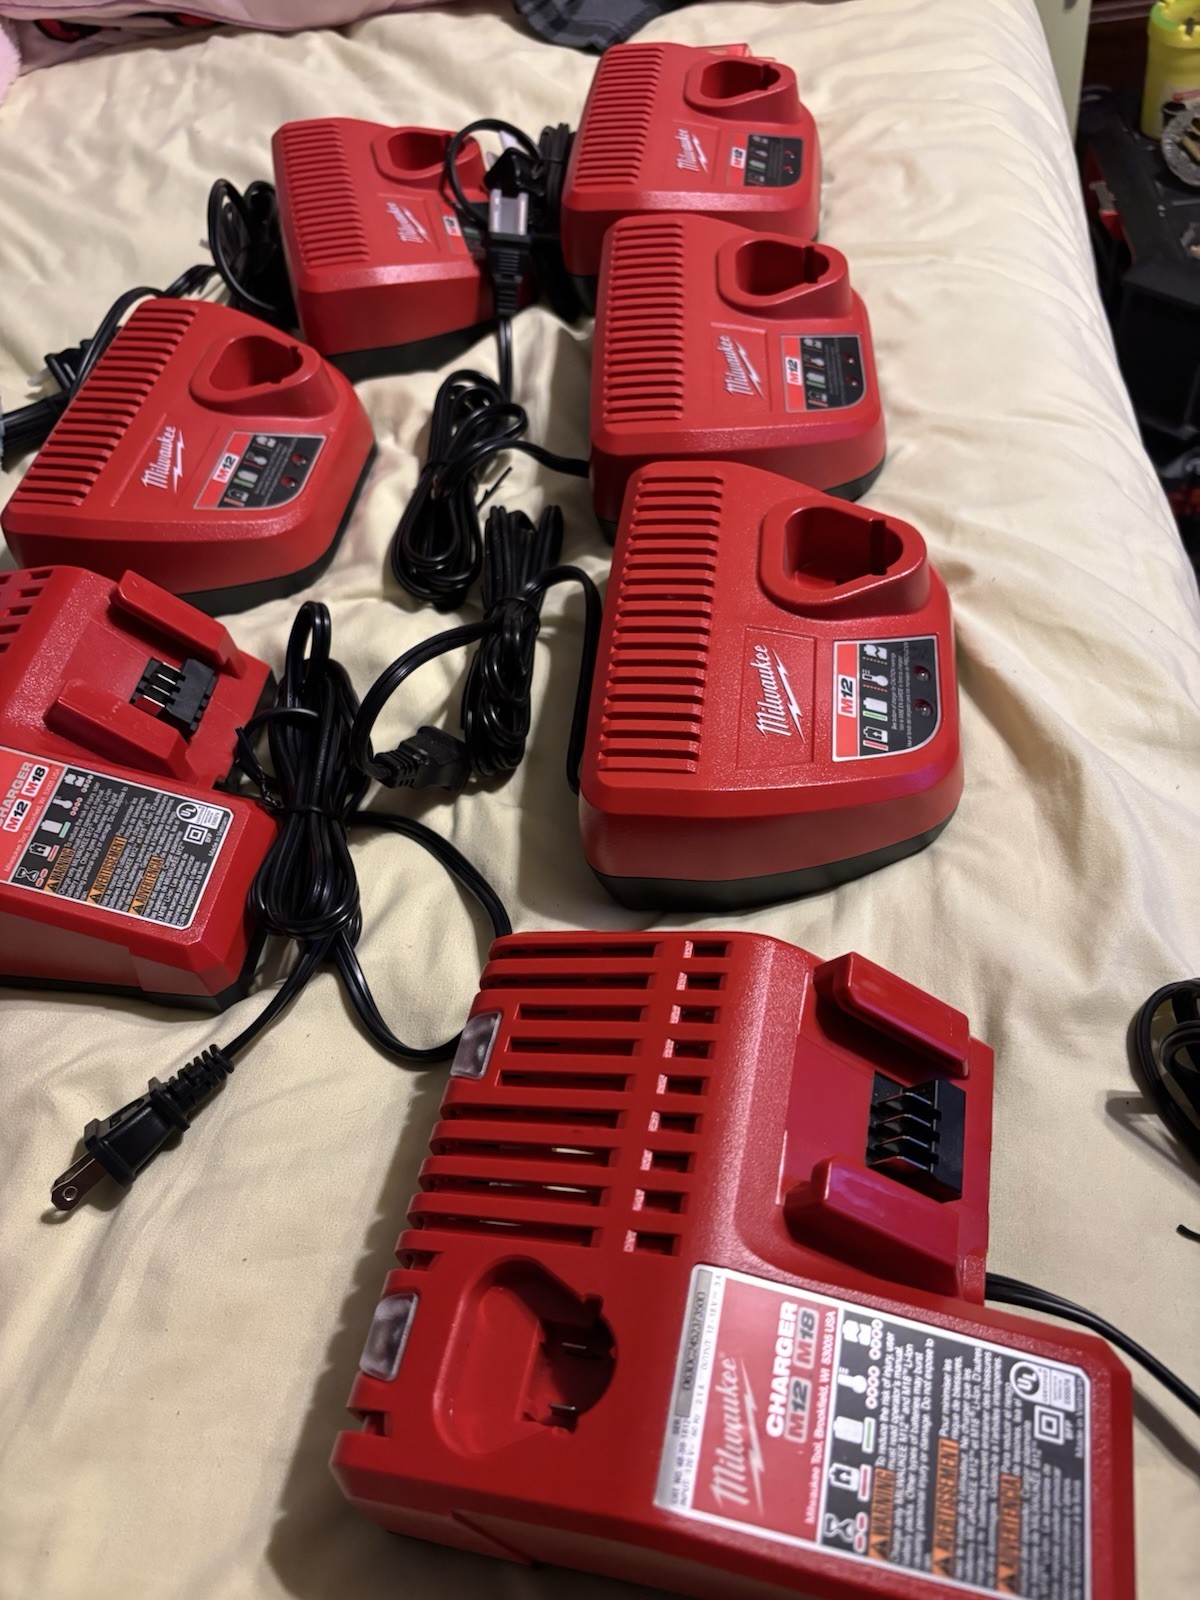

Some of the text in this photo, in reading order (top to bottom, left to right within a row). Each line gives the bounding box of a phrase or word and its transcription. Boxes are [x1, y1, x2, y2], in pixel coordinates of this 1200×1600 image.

[717, 335, 755, 395] Milwaukee
[787, 359, 799, 383] M12
[141, 426, 176, 490] Milwaukee
[216, 457, 236, 478] M12
[750, 645, 792, 739] Milwaukee
[840, 677, 852, 714] M12
[5, 766, 46, 830] M12 M18
[50, 848, 74, 881] WARNING
[92, 836, 126, 892] AVERTISSEMENT
[134, 856, 163, 903] ADVERTENCIA
[824, 1309, 838, 1333] USA
[821, 1333, 835, 1366] 53005
[885, 1330, 896, 1353] user
[924, 1336, 934, 1349] to
[764, 1299, 798, 1439] CHARGER
[787, 1309, 817, 1439] M12 M18
[913, 1350, 923, 1375] burst
[922, 1346, 935, 1381] expose
[942, 1356, 953, 1373] les
[882, 1377, 892, 1389] of
[912, 1374, 923, 1395] may
[922, 1379, 931, 1396] not
[1016, 1367, 1036, 1392] UL
[880, 1388, 891, 1406] risk
[920, 1394, 931, 1412] Do
[951, 1397, 961, 1412] de
[813, 1383, 830, 1438] Brookfield,
[879, 1405, 889, 1422] the
[909, 1394, 921, 1434] batteries
[711, 1357, 749, 1505] Milwaukee
[876, 1421, 888, 1455] reduce
[887, 1423, 899, 1446] read
[938, 1414, 949, 1437] Pour
[810, 1438, 824, 1465] Tool,
[893, 1443, 907, 1506] MILWAUKEE
[900, 1395, 910, 1415] and
[909, 1433, 918, 1446] of
[875, 1454, 885, 1468] To
[885, 1445, 897, 1471] must
[803, 1464, 821, 1526] Milwaukee
[870, 1467, 894, 1536] WARNING
